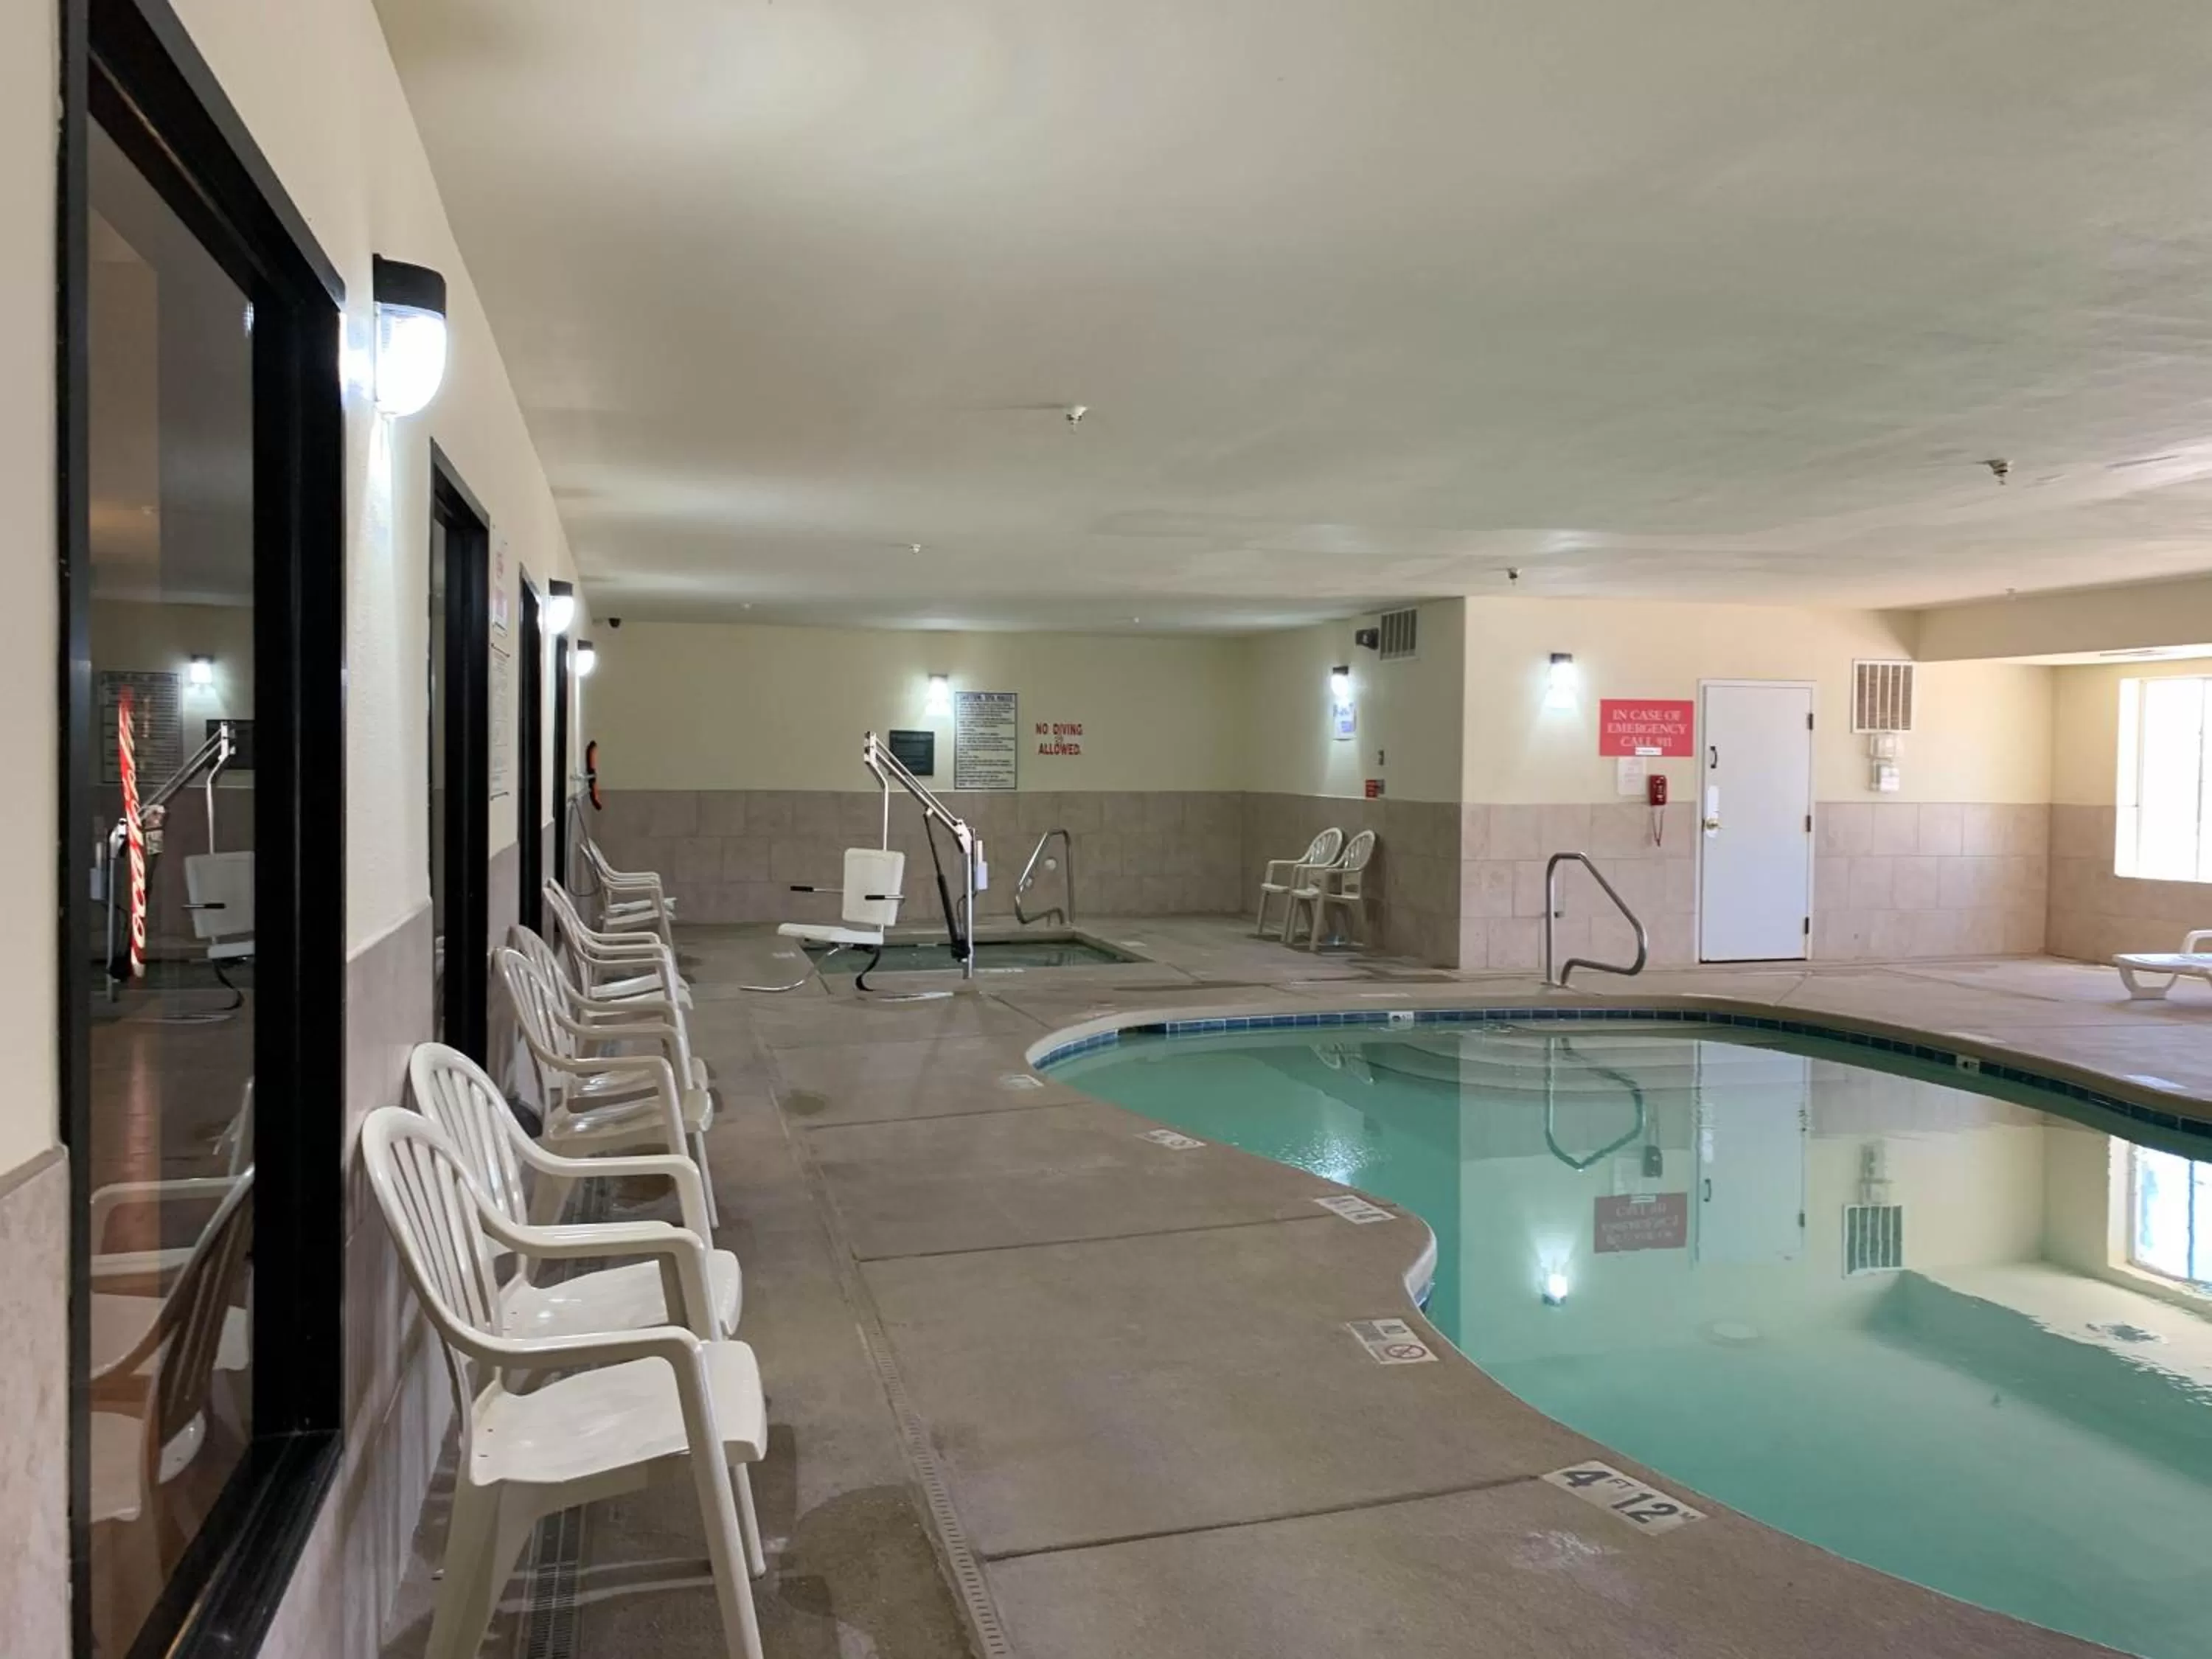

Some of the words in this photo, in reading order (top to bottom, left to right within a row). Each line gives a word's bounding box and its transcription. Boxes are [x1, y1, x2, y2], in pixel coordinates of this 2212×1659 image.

[1613, 709, 1627, 720] IN
[1629, 709, 1663, 721] CASE
[1664, 710, 1681, 721] OF
[1035, 722, 1048, 735] NO
[1052, 723, 1083, 736] DIVING
[1607, 722, 1688, 735] EMERGENCY
[1620, 736, 1653, 747] CALL
[1562, 1471, 1613, 1488] 4
[1605, 1478, 1635, 1489] FT
